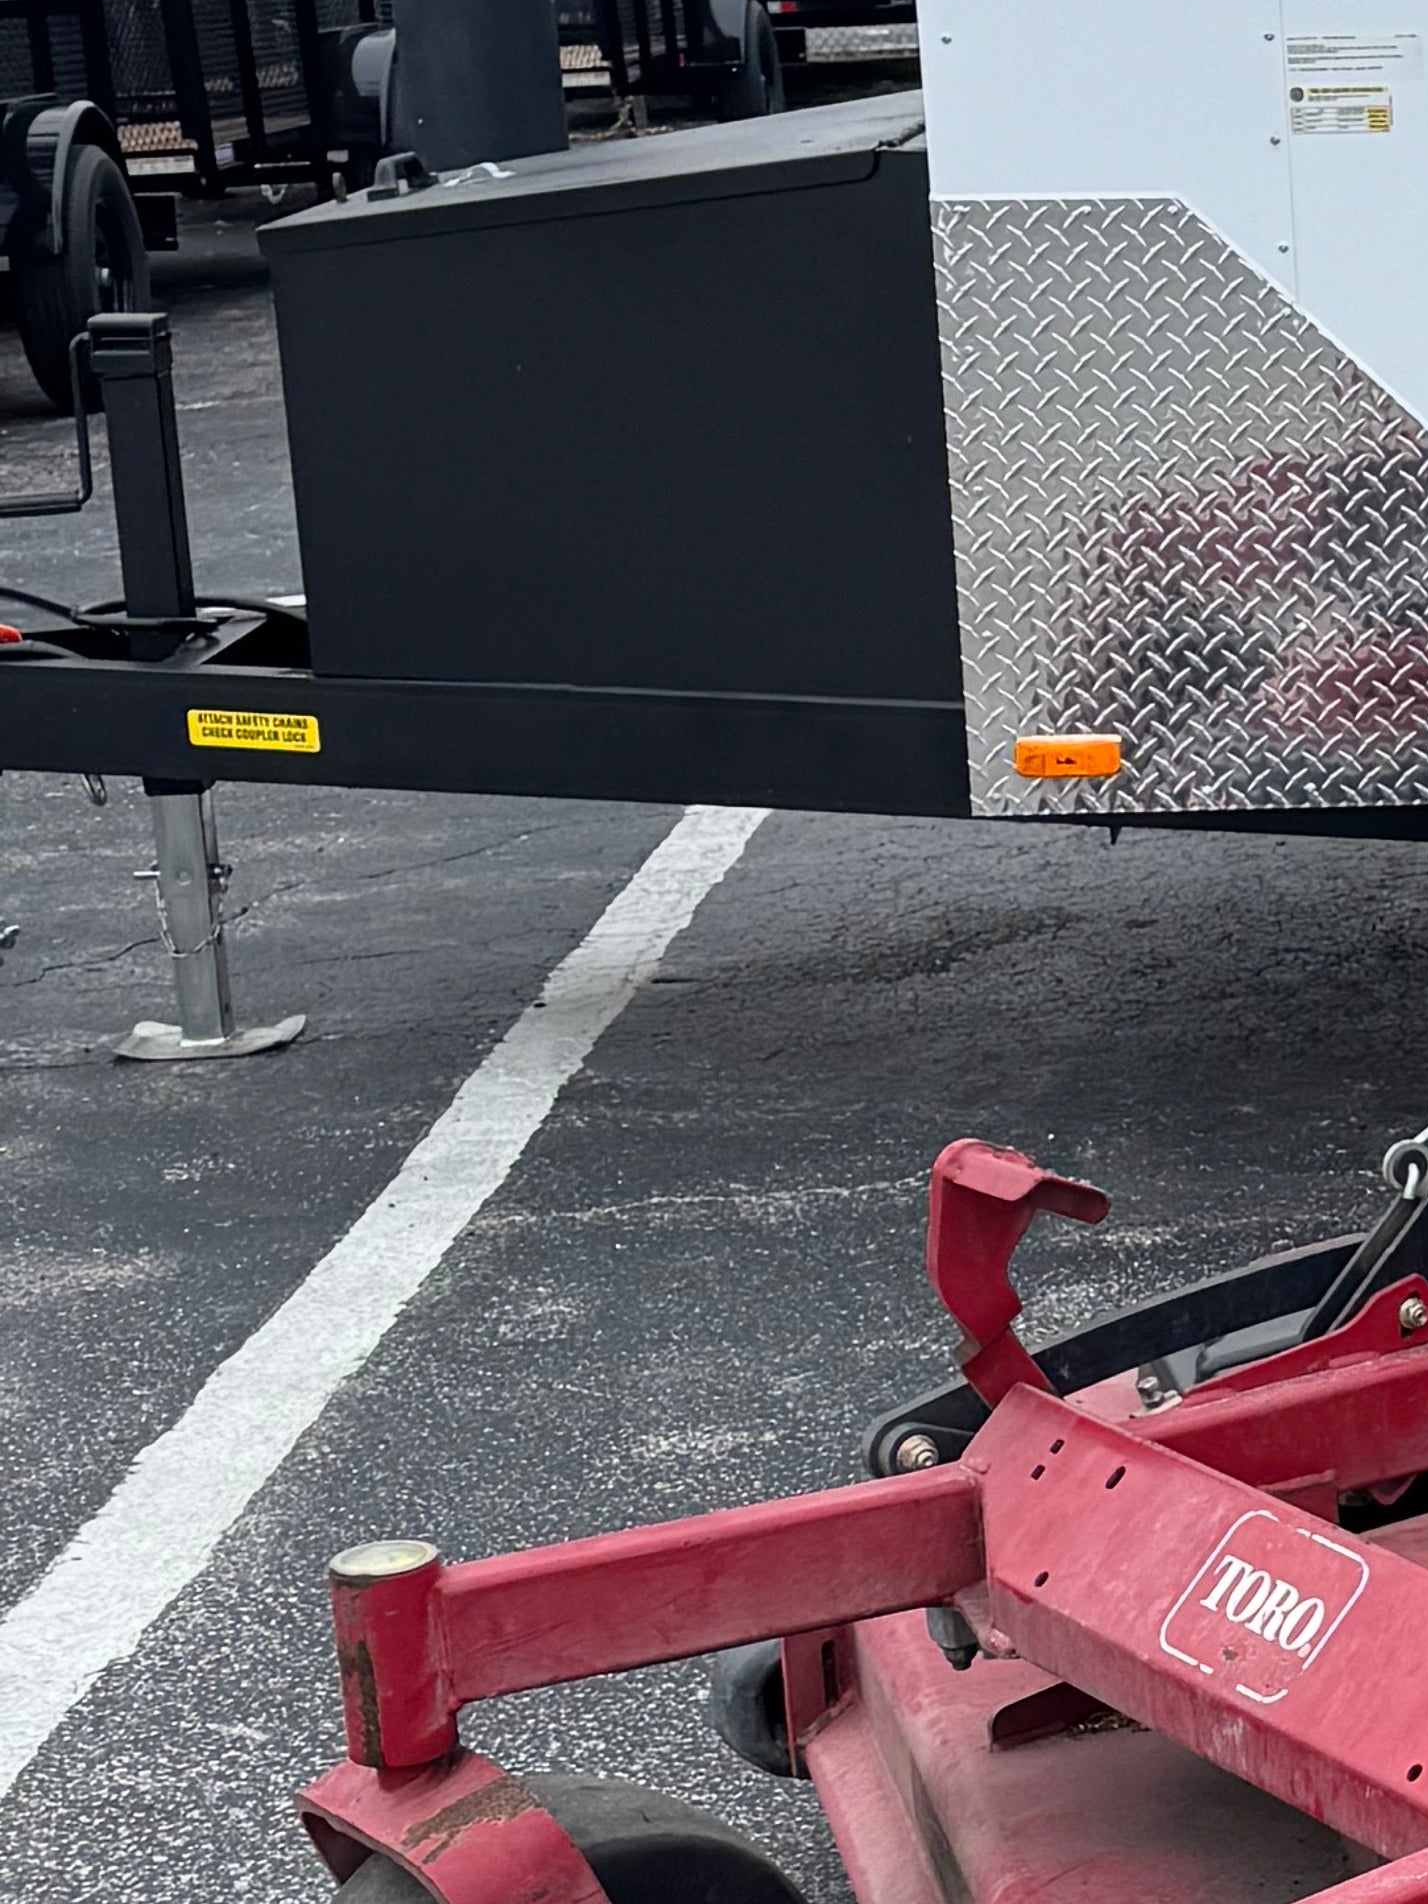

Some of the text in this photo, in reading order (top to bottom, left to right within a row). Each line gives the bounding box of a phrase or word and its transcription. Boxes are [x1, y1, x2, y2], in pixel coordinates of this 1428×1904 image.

[235, 714, 270, 727] SAFETY
[273, 716, 308, 729] CHAINS
[202, 726, 307, 742] CHECK COUPLER LOCK
